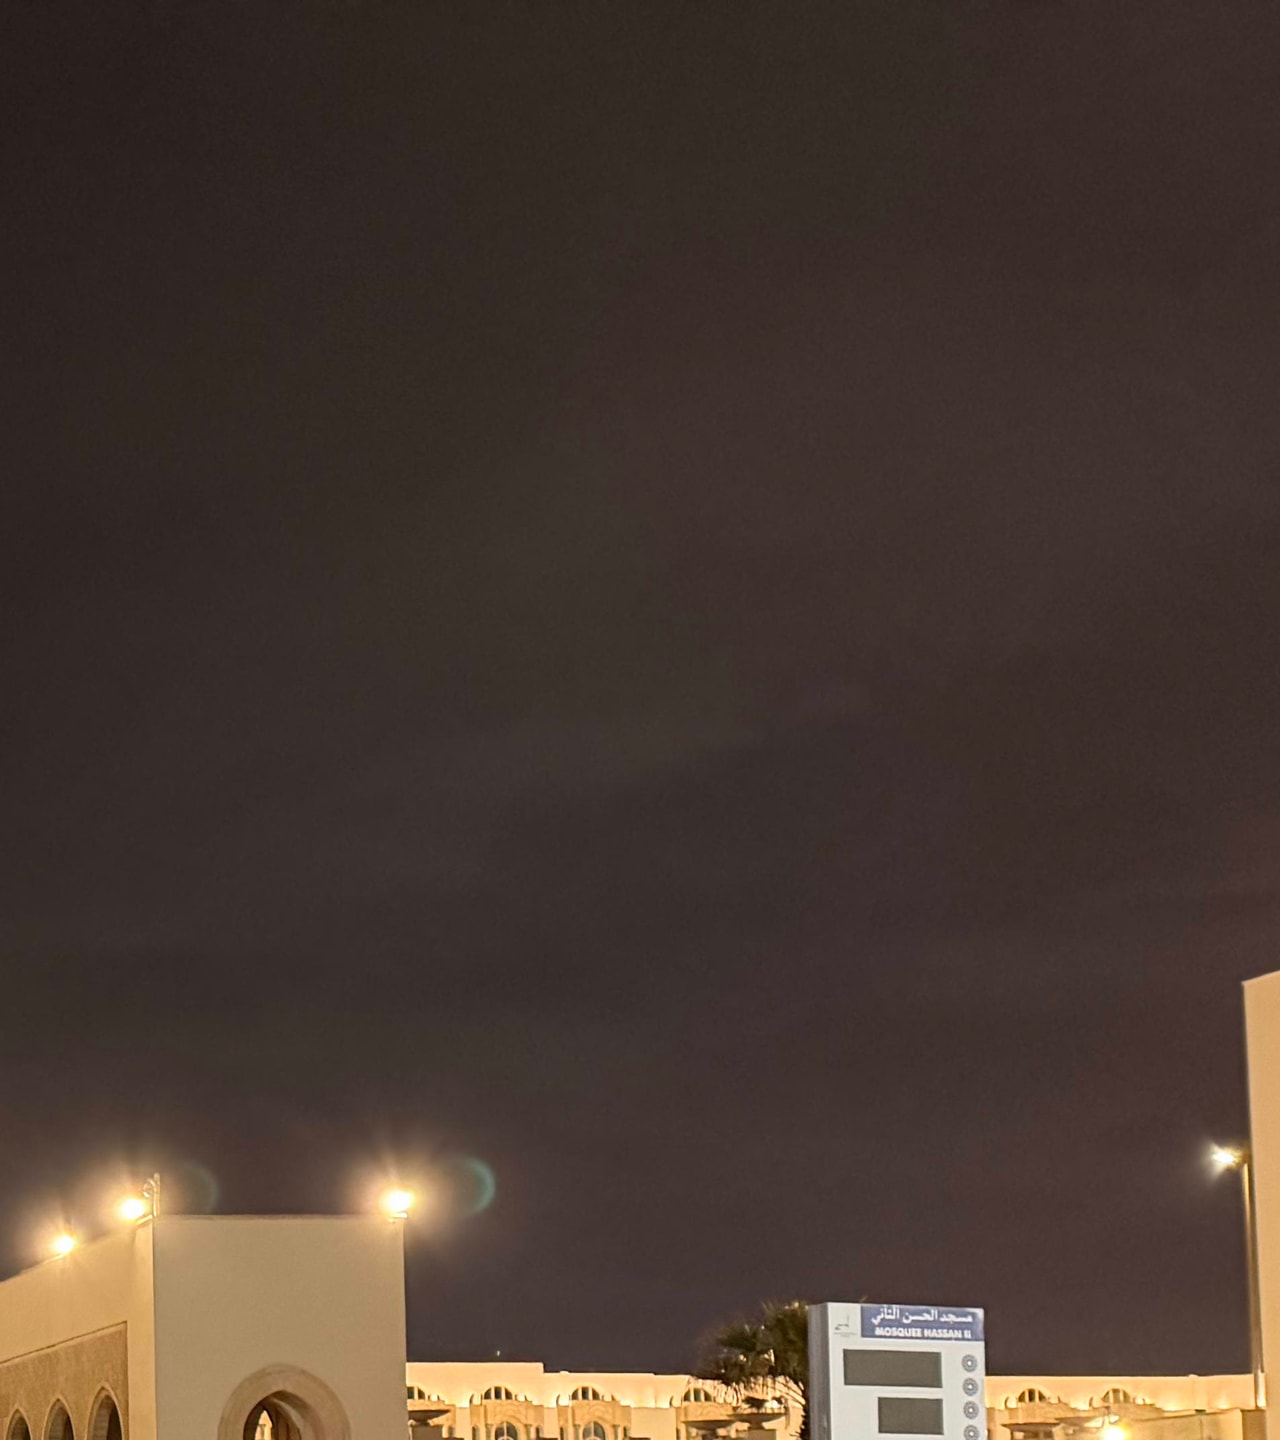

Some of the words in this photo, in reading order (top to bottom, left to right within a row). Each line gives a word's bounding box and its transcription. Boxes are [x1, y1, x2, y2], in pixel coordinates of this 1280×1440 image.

[872, 1306, 899, 1325] الثاني
[903, 1309, 938, 1324] الحسن
[941, 1311, 973, 1324] مسجد
[875, 1326, 922, 1337] MOSQUEE
[924, 1328, 962, 1338] HASSAN
[964, 1330, 971, 1339] II
